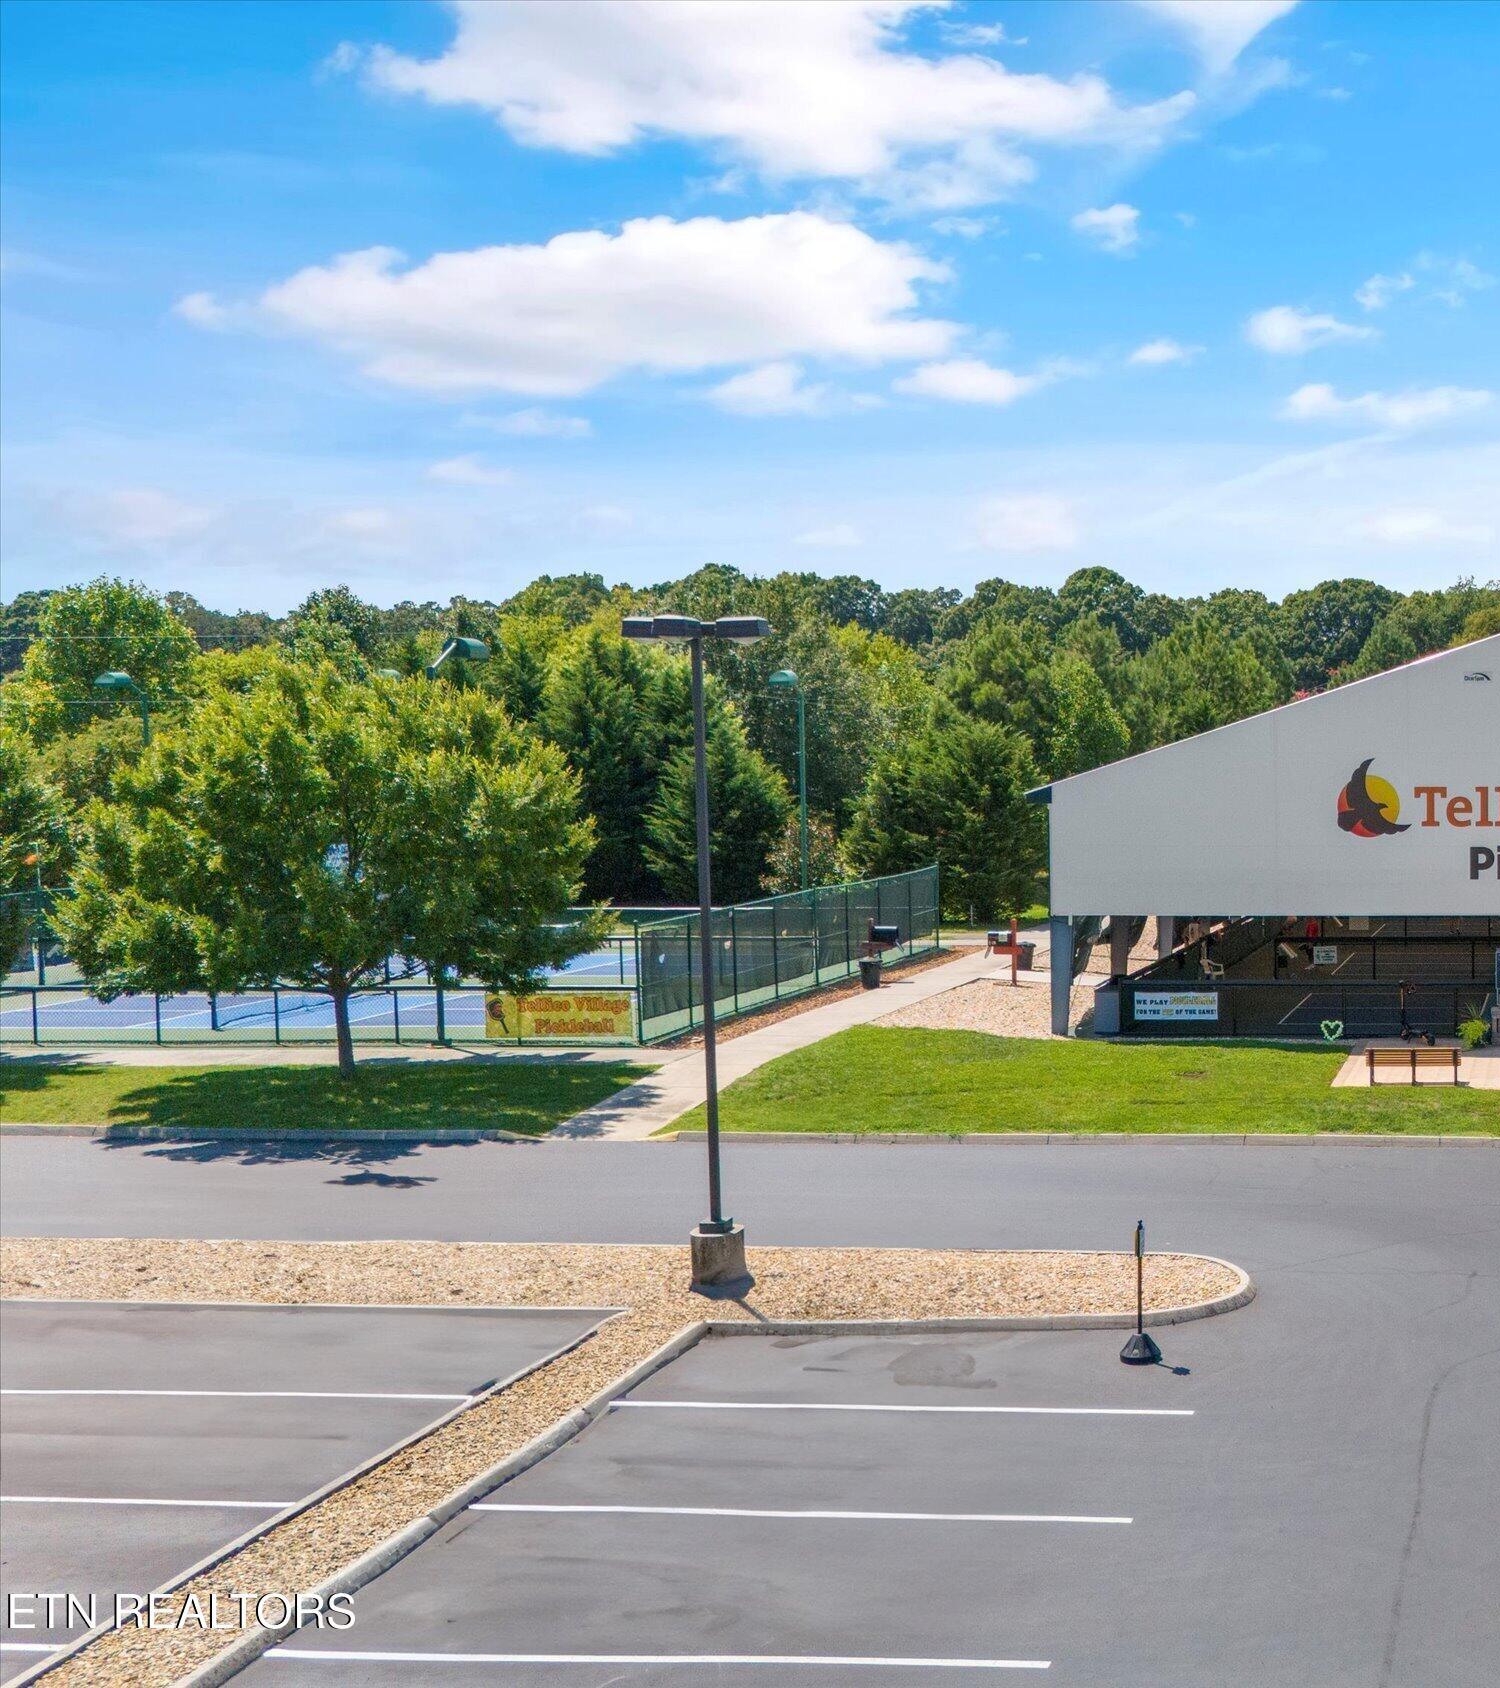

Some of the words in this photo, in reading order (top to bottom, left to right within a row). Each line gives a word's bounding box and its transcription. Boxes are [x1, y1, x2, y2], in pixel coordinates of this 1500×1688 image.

[517, 996, 570, 1012] Tellico
[573, 996, 630, 1015] Village
[534, 1018, 615, 1034] Pickleball
